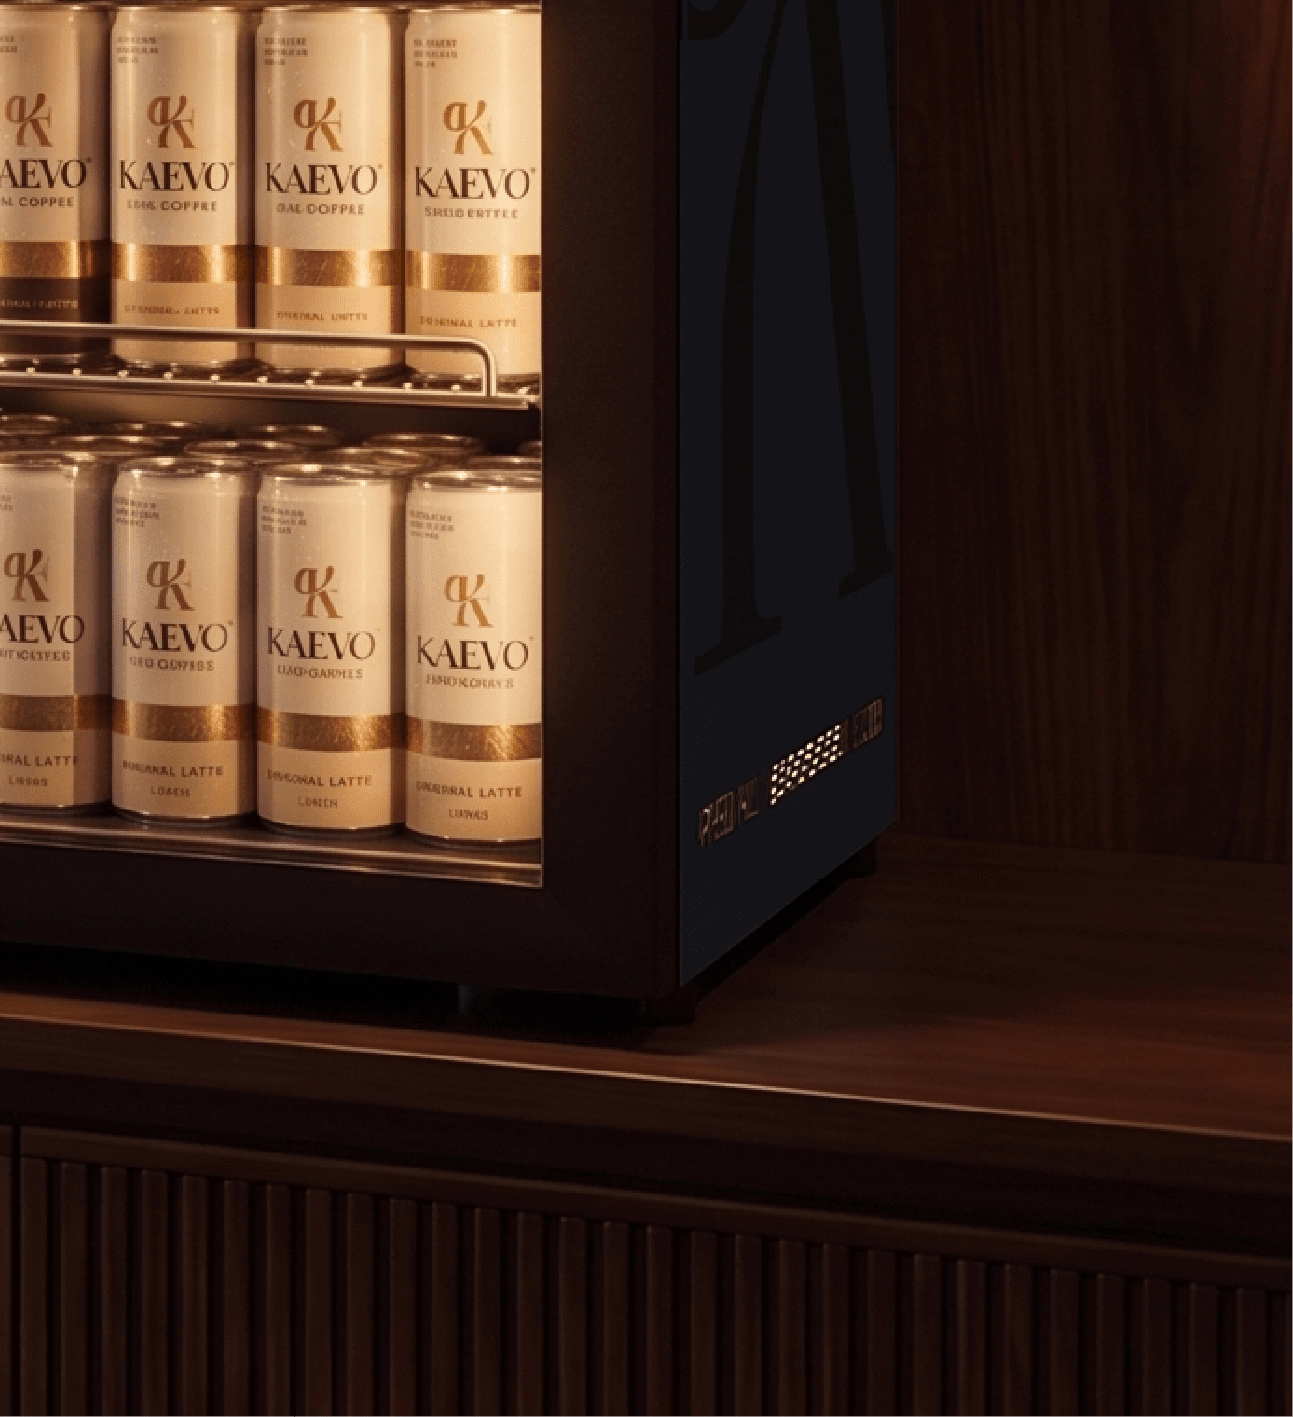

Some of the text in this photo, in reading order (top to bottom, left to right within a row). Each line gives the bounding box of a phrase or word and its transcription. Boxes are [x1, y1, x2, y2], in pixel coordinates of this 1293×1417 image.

[119, 159, 230, 192] KAEVO
[265, 162, 378, 195] KAEVO
[415, 166, 530, 200] KAEVO
[122, 617, 228, 652] KAEVO
[267, 627, 376, 660] KAEVO
[417, 635, 529, 671] KAEVO
